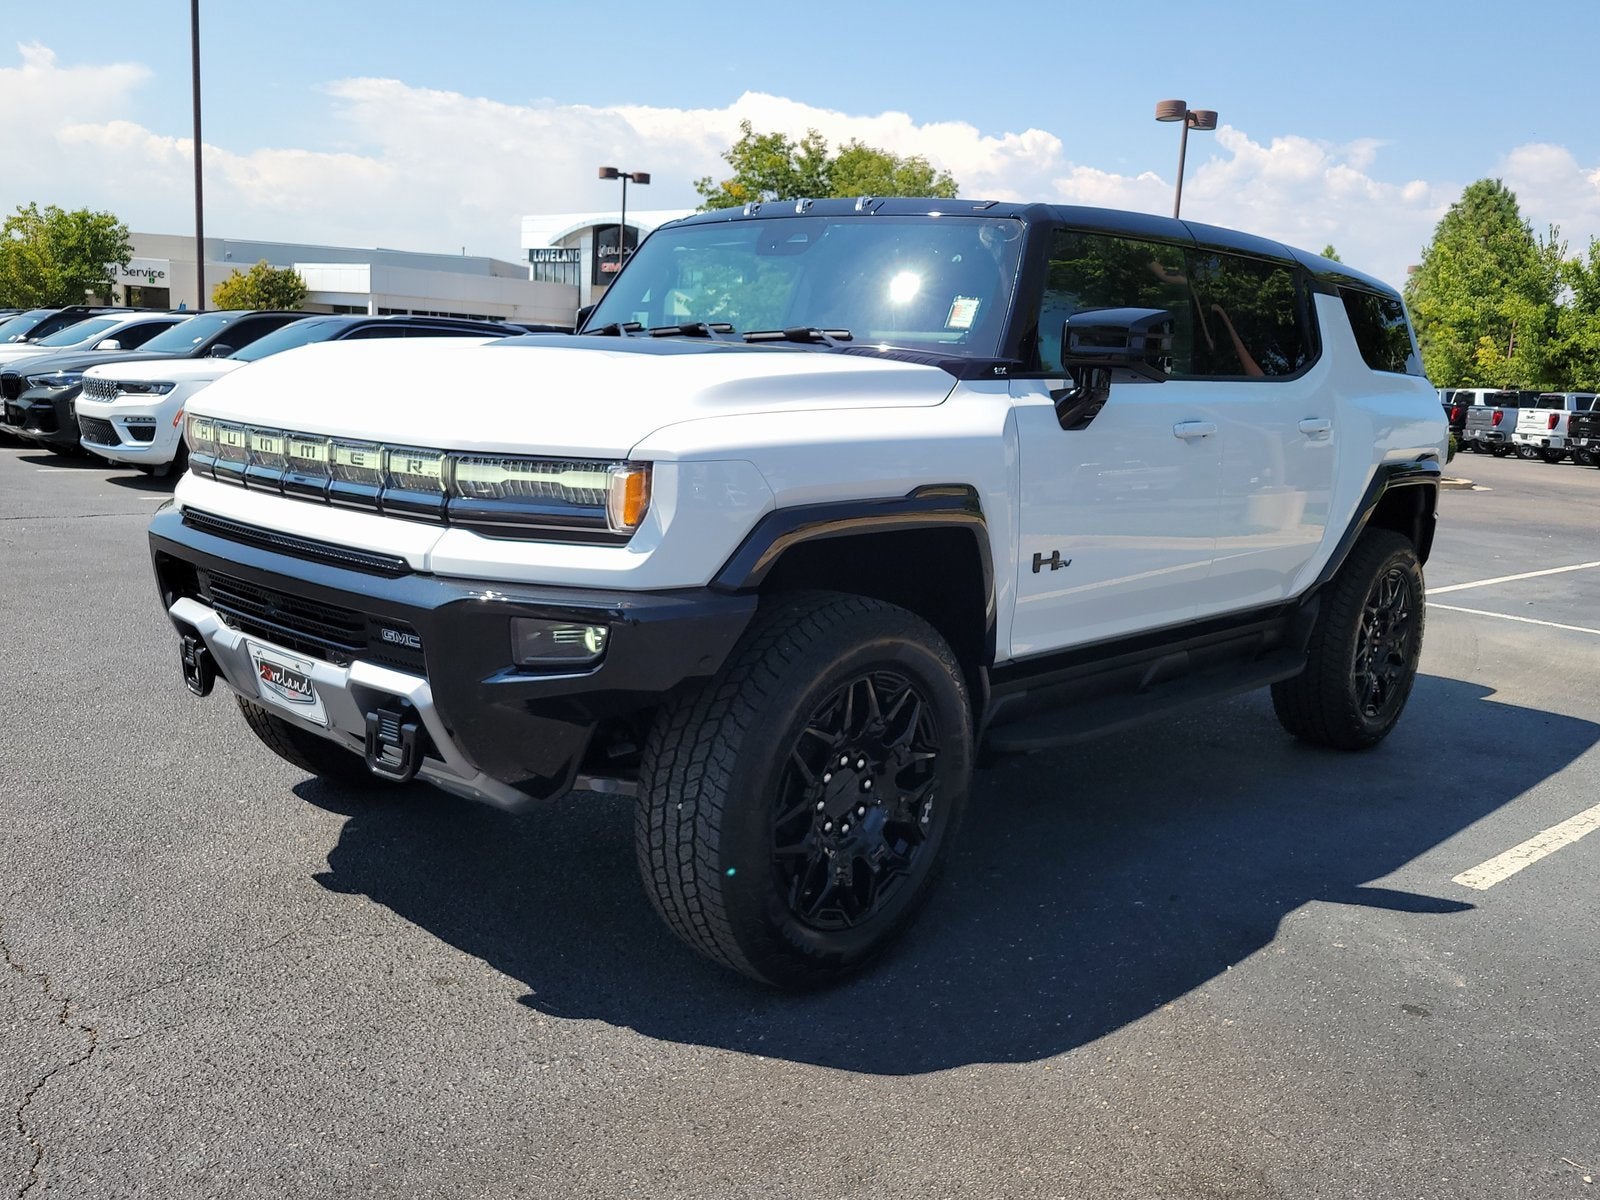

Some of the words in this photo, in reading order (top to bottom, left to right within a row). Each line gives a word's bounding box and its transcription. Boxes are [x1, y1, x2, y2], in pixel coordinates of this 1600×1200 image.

[533, 249, 580, 262] LOVELAND
[607, 246, 633, 255] BUCK
[122, 265, 165, 278] Service
[382, 628, 421, 648] GMC
